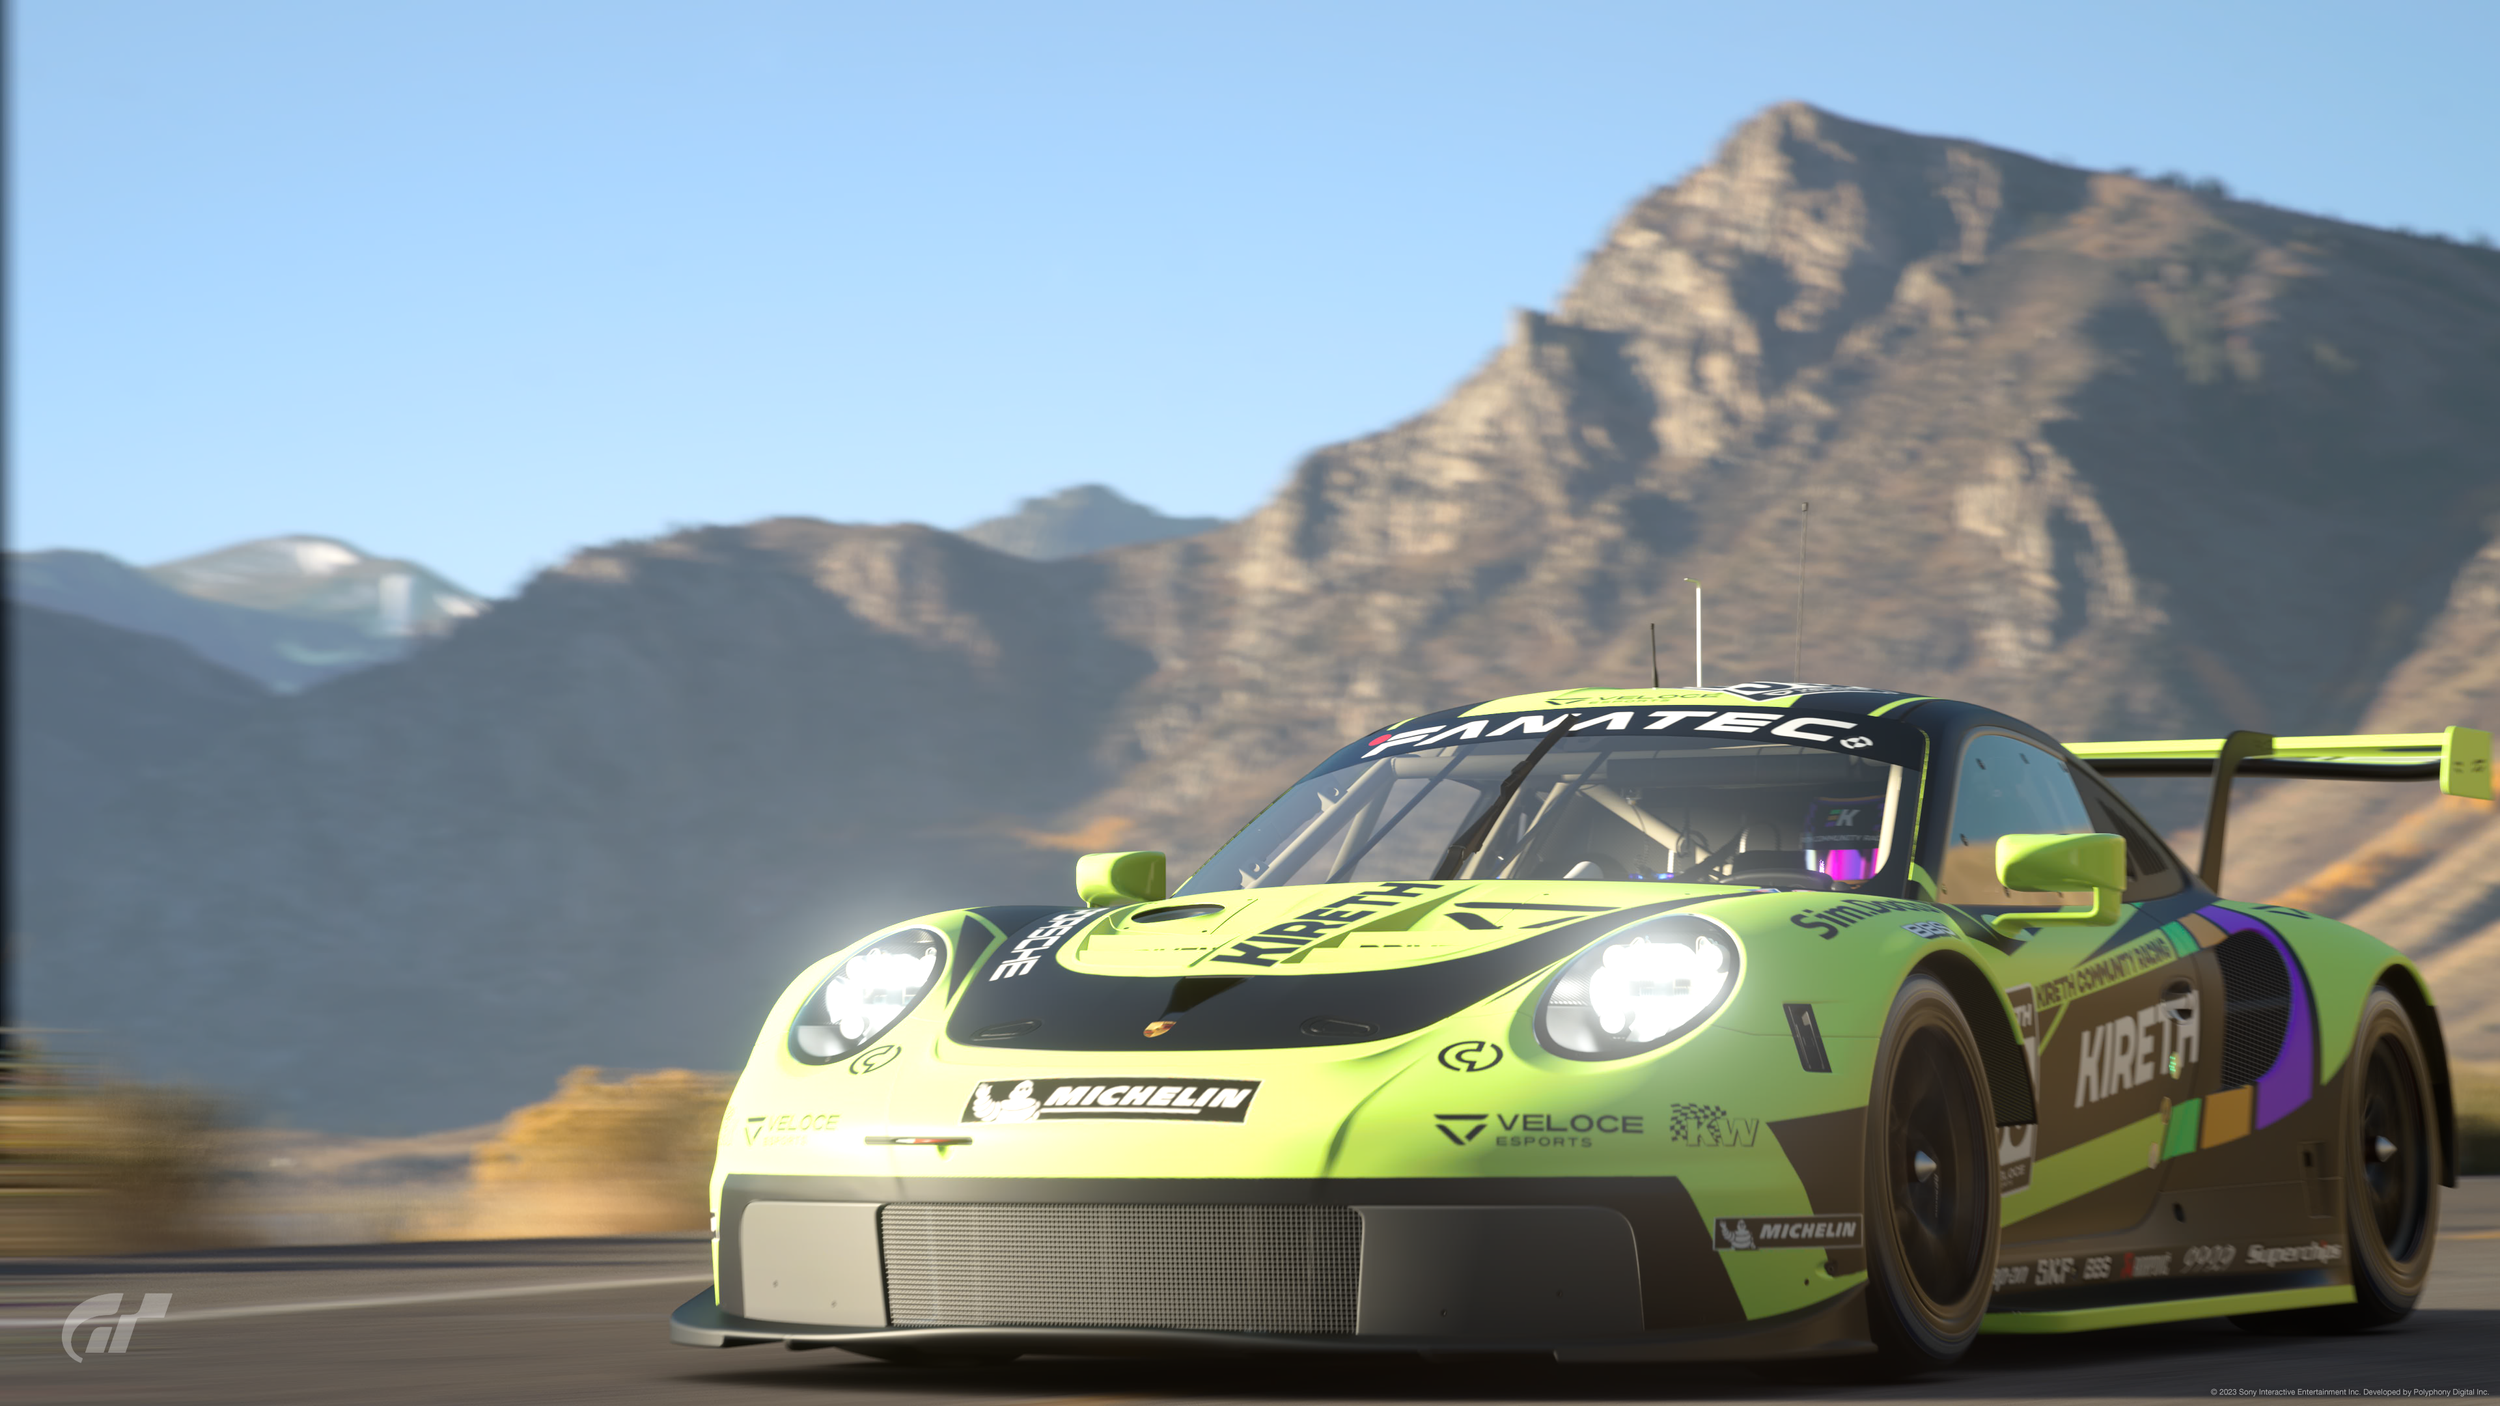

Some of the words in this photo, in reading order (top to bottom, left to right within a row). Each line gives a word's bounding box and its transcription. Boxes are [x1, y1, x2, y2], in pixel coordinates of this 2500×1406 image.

[1600, 692, 1723, 701] VELOCE
[1361, 710, 1857, 759] FANATEC
[1210, 882, 1446, 967] KIRETH
[1900, 921, 1960, 939] BBS
[2077, 950, 2139, 994] COMMUNITY
[2074, 989, 2199, 1109] KIRETH
[1043, 1085, 1252, 1109] MICHELIN
[769, 1114, 842, 1131] VELOCE
[1496, 1113, 1645, 1134] VELOCE
[1685, 1117, 1760, 1148] KW
[1496, 1137, 1593, 1148] ESPORTS
[1759, 1221, 1857, 1240] MICHELIN
[2034, 1257, 2076, 1286] SKF
